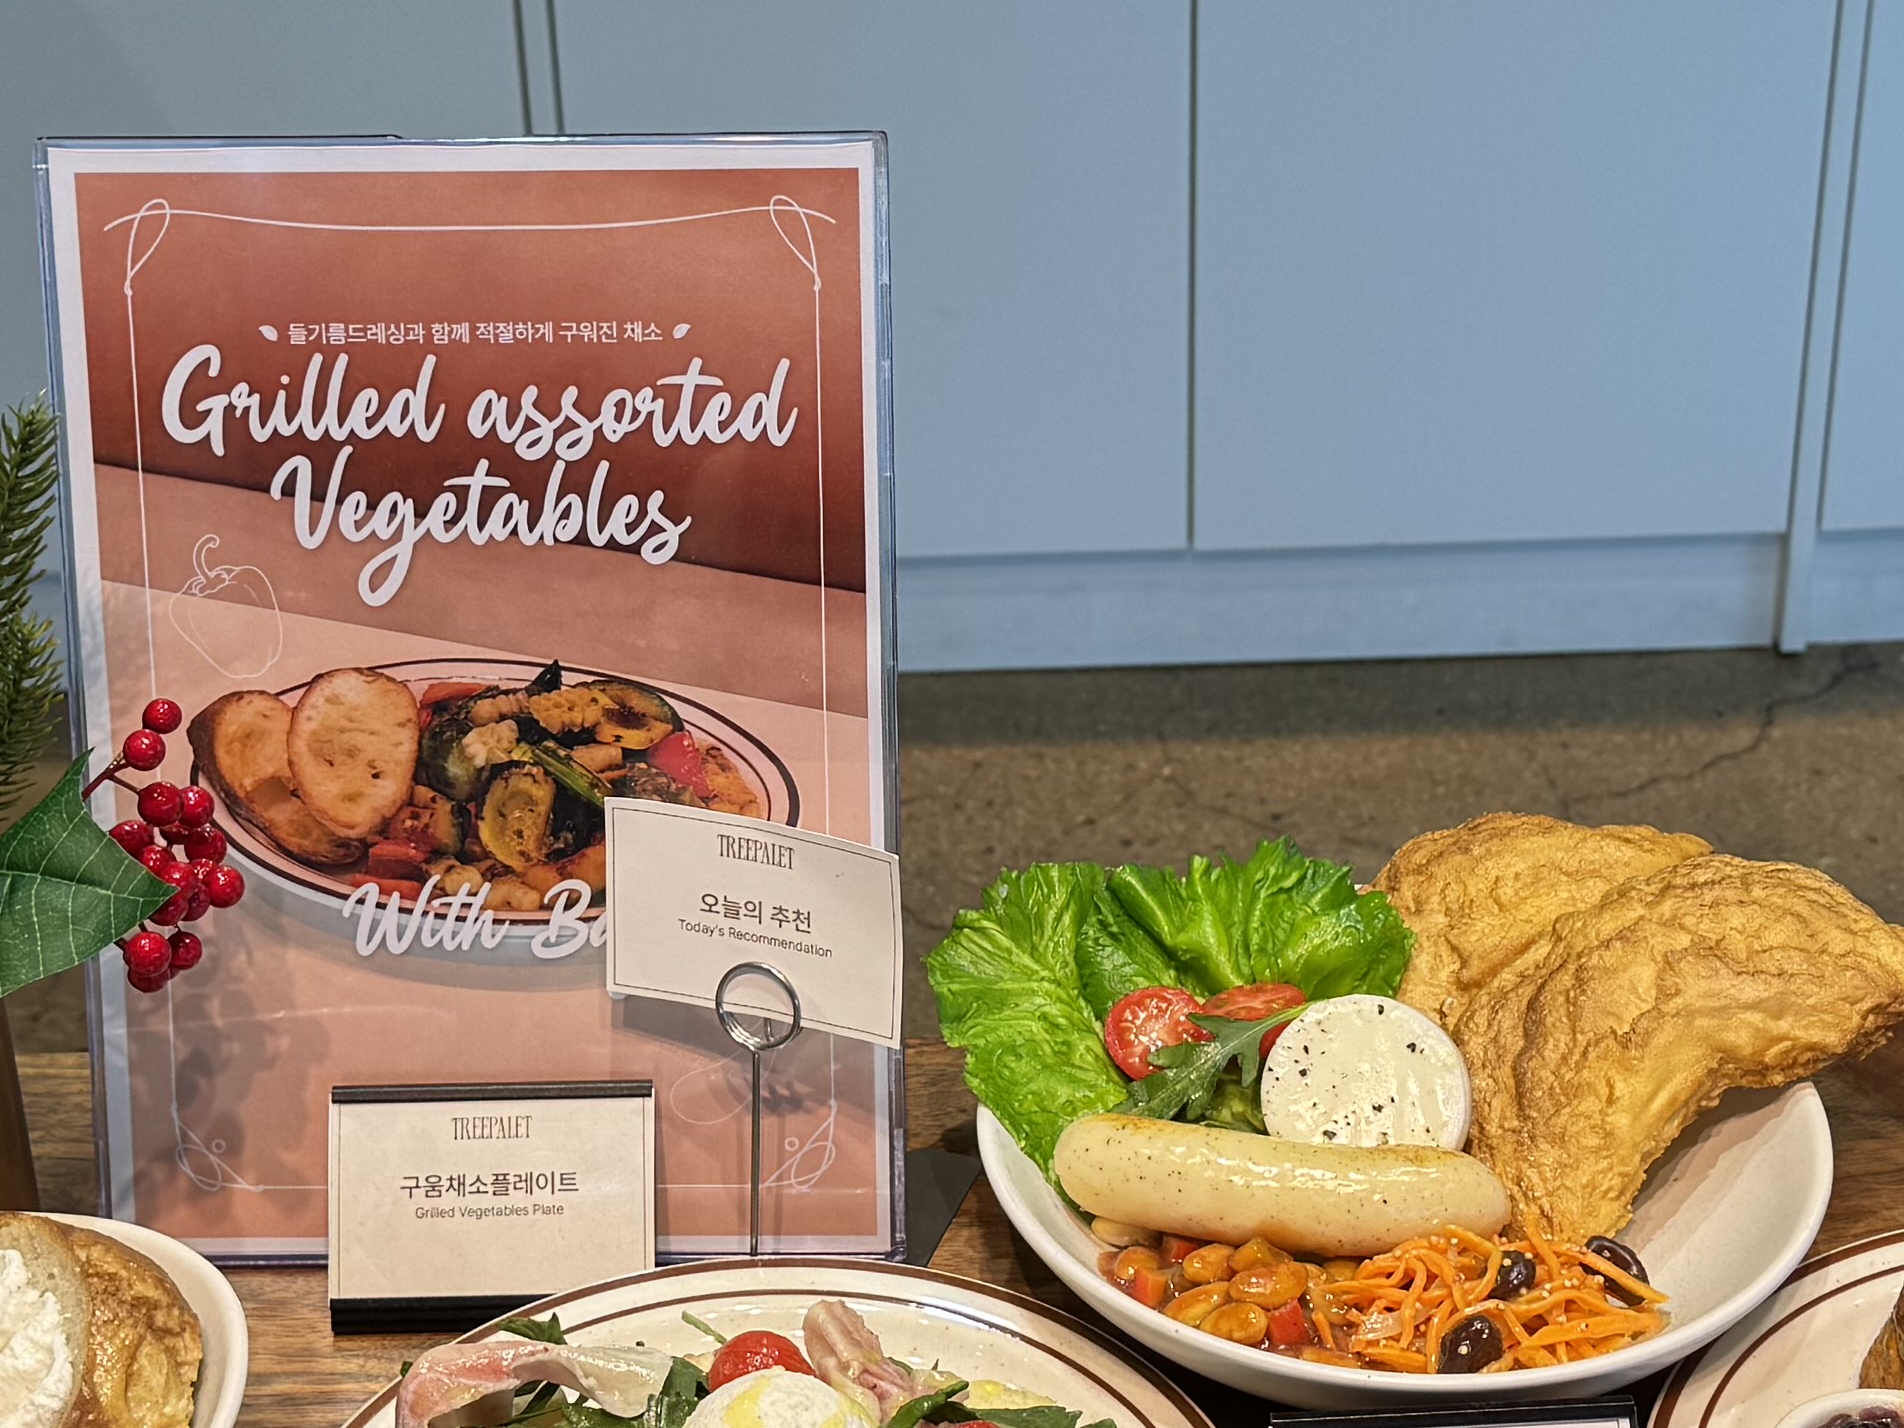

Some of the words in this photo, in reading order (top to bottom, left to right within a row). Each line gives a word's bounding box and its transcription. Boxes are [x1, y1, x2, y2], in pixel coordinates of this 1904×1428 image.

[287, 321, 426, 346] 들기름드레싱과
[430, 321, 470, 344] 함께
[475, 320, 554, 344] 적절하게
[558, 320, 618, 344] 구워진
[623, 320, 663, 343] 채소
[162, 345, 445, 456] Grilled
[467, 358, 798, 461] assorted
[270, 446, 692, 606] Vegetables
[717, 834, 794, 870] TREEPALET
[343, 875, 510, 958] With
[700, 893, 762, 925] 오늘의
[770, 905, 811, 934] 추천
[679, 918, 724, 938] Today's
[729, 928, 832, 958] Recommendation
[452, 1116, 532, 1141] TREEPALET
[399, 1171, 580, 1200] 구움채소플레이트
[415, 1205, 455, 1219] Grilled
[459, 1203, 529, 1220] Vegetables
[533, 1202, 564, 1217] Plate
